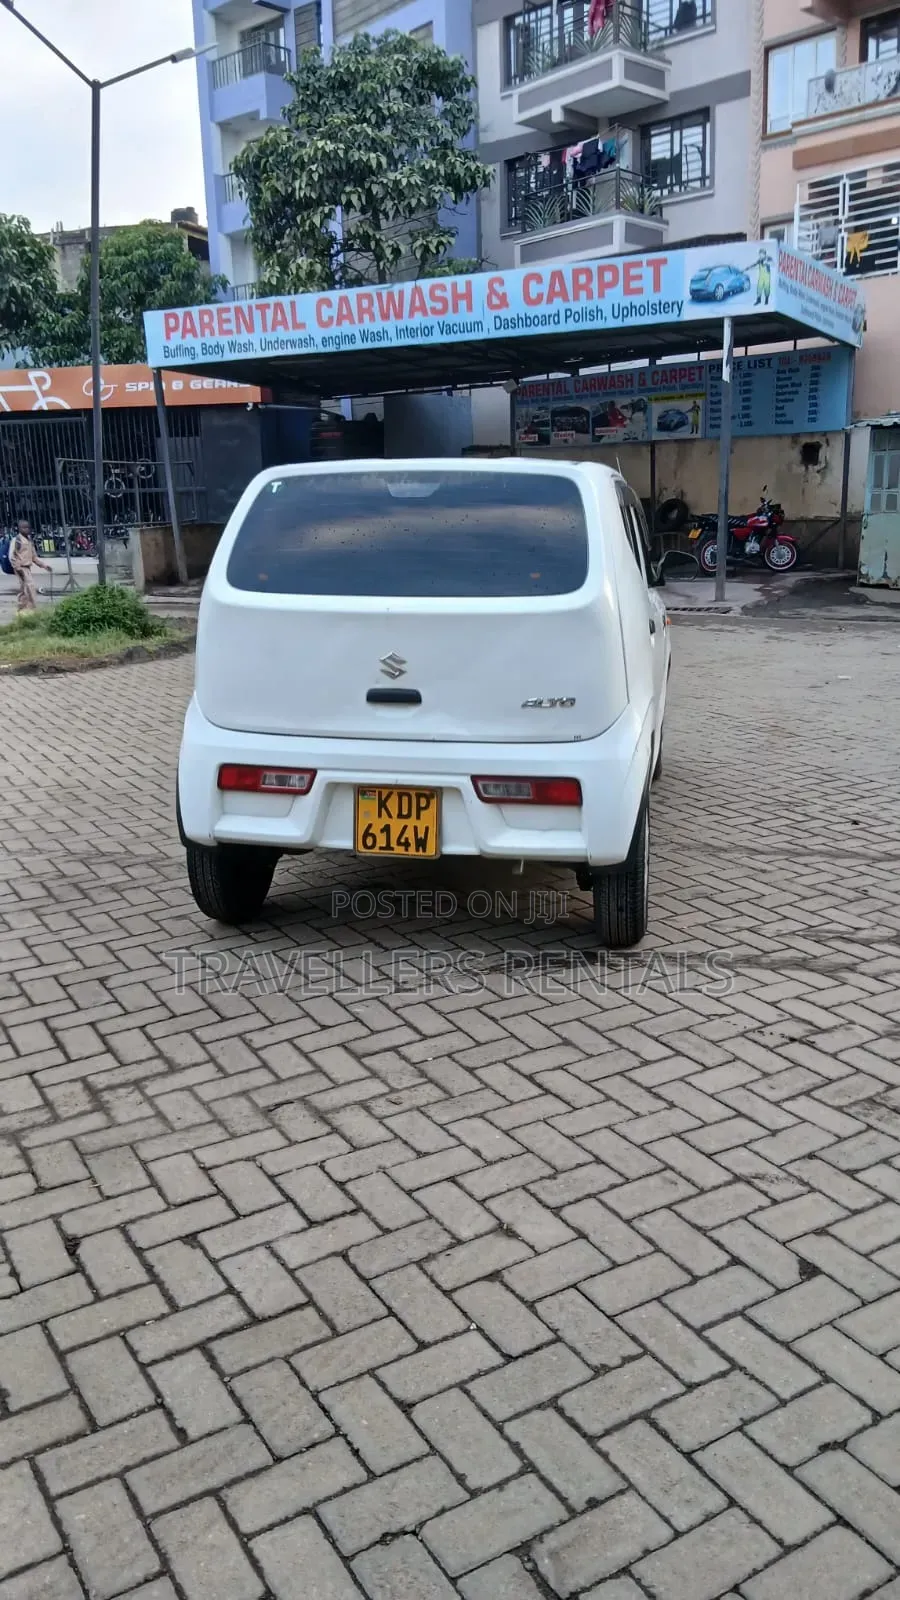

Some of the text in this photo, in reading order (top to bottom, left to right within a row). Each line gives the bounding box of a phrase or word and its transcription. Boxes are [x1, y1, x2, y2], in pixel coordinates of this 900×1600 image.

[164, 257, 668, 340] PARENTAL CARWASH & CARPET
[163, 343, 198, 359] Buffing,
[201, 340, 225, 357] Body
[227, 338, 257, 354] Wash,
[260, 335, 318, 352] Underwash,
[321, 329, 356, 350] engine
[359, 328, 392, 345] Wash,
[395, 323, 434, 340] Interior
[494, 307, 560, 331] Dashboard
[565, 302, 607, 324] Polish,
[611, 299, 684, 320] Upholstery
[747, 357, 773, 370] LIST
[574, 373, 634, 393] CARWASH
[651, 365, 705, 385] CARPET
[377, 790, 431, 820] KDP
[362, 823, 429, 853] 614W
